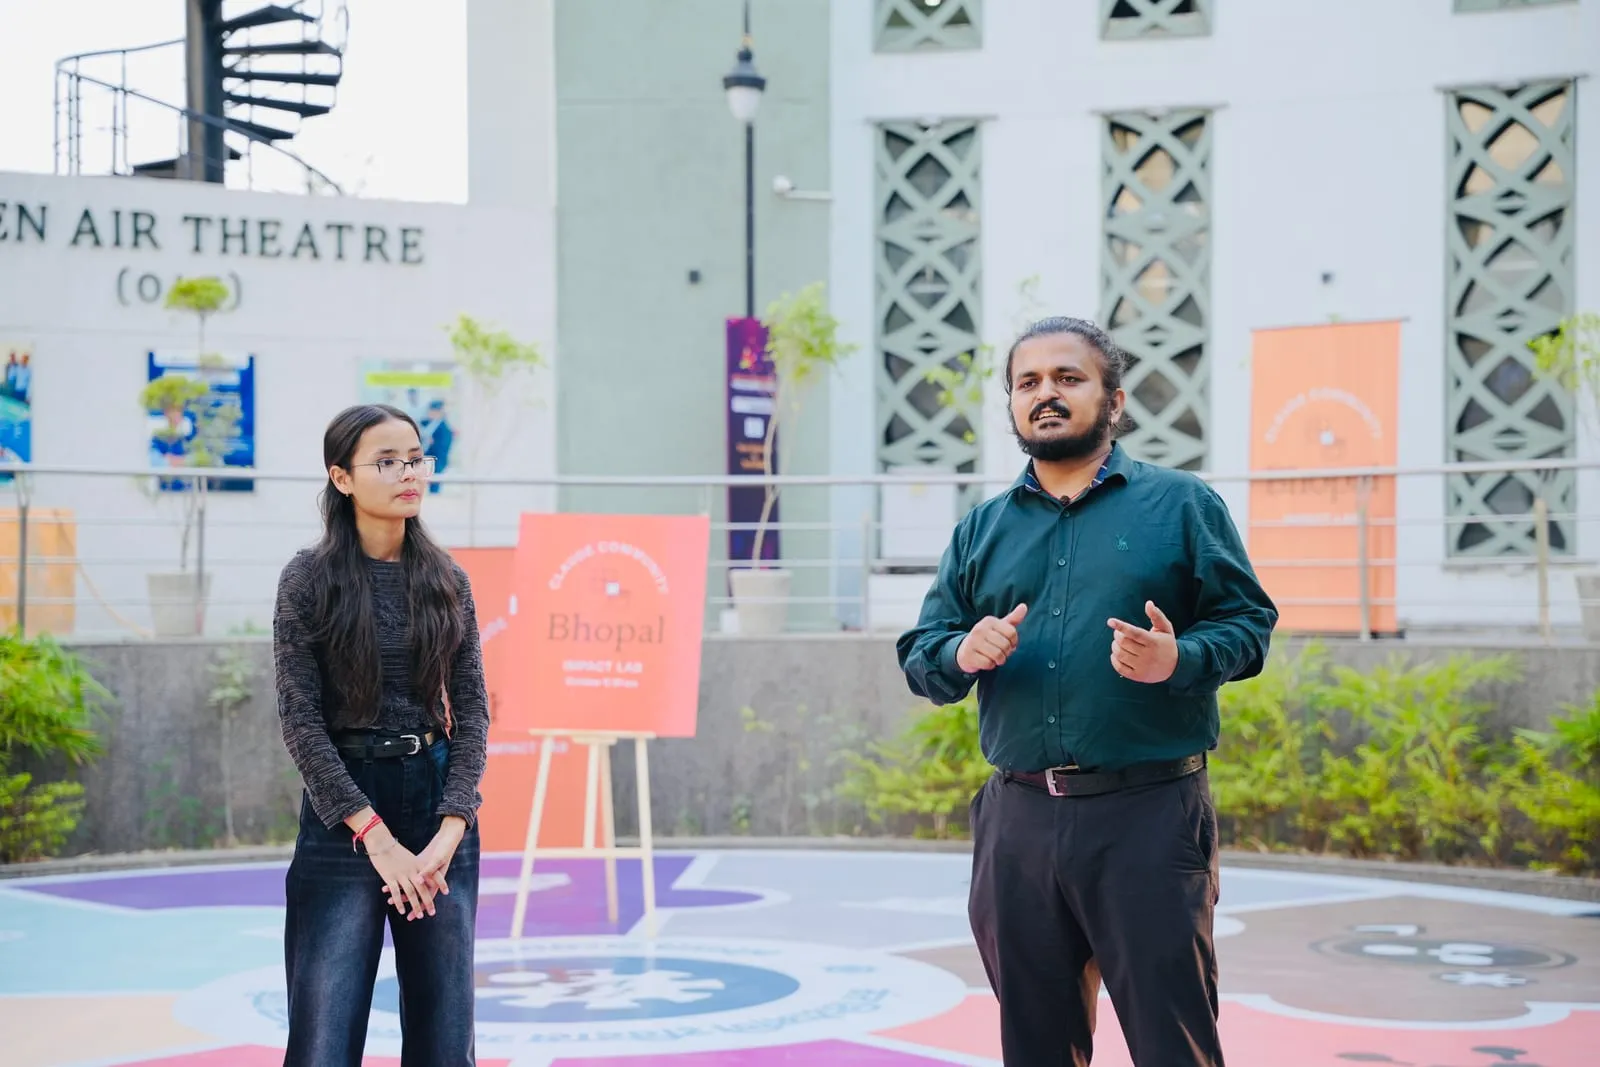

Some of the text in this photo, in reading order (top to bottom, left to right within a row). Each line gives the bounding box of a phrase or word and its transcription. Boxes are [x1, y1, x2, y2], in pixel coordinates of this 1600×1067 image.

[70, 209, 160, 250] AIR
[184, 216, 425, 264] THEATRE
[118, 267, 242, 307] (O)
[548, 613, 664, 652] Bhopal
